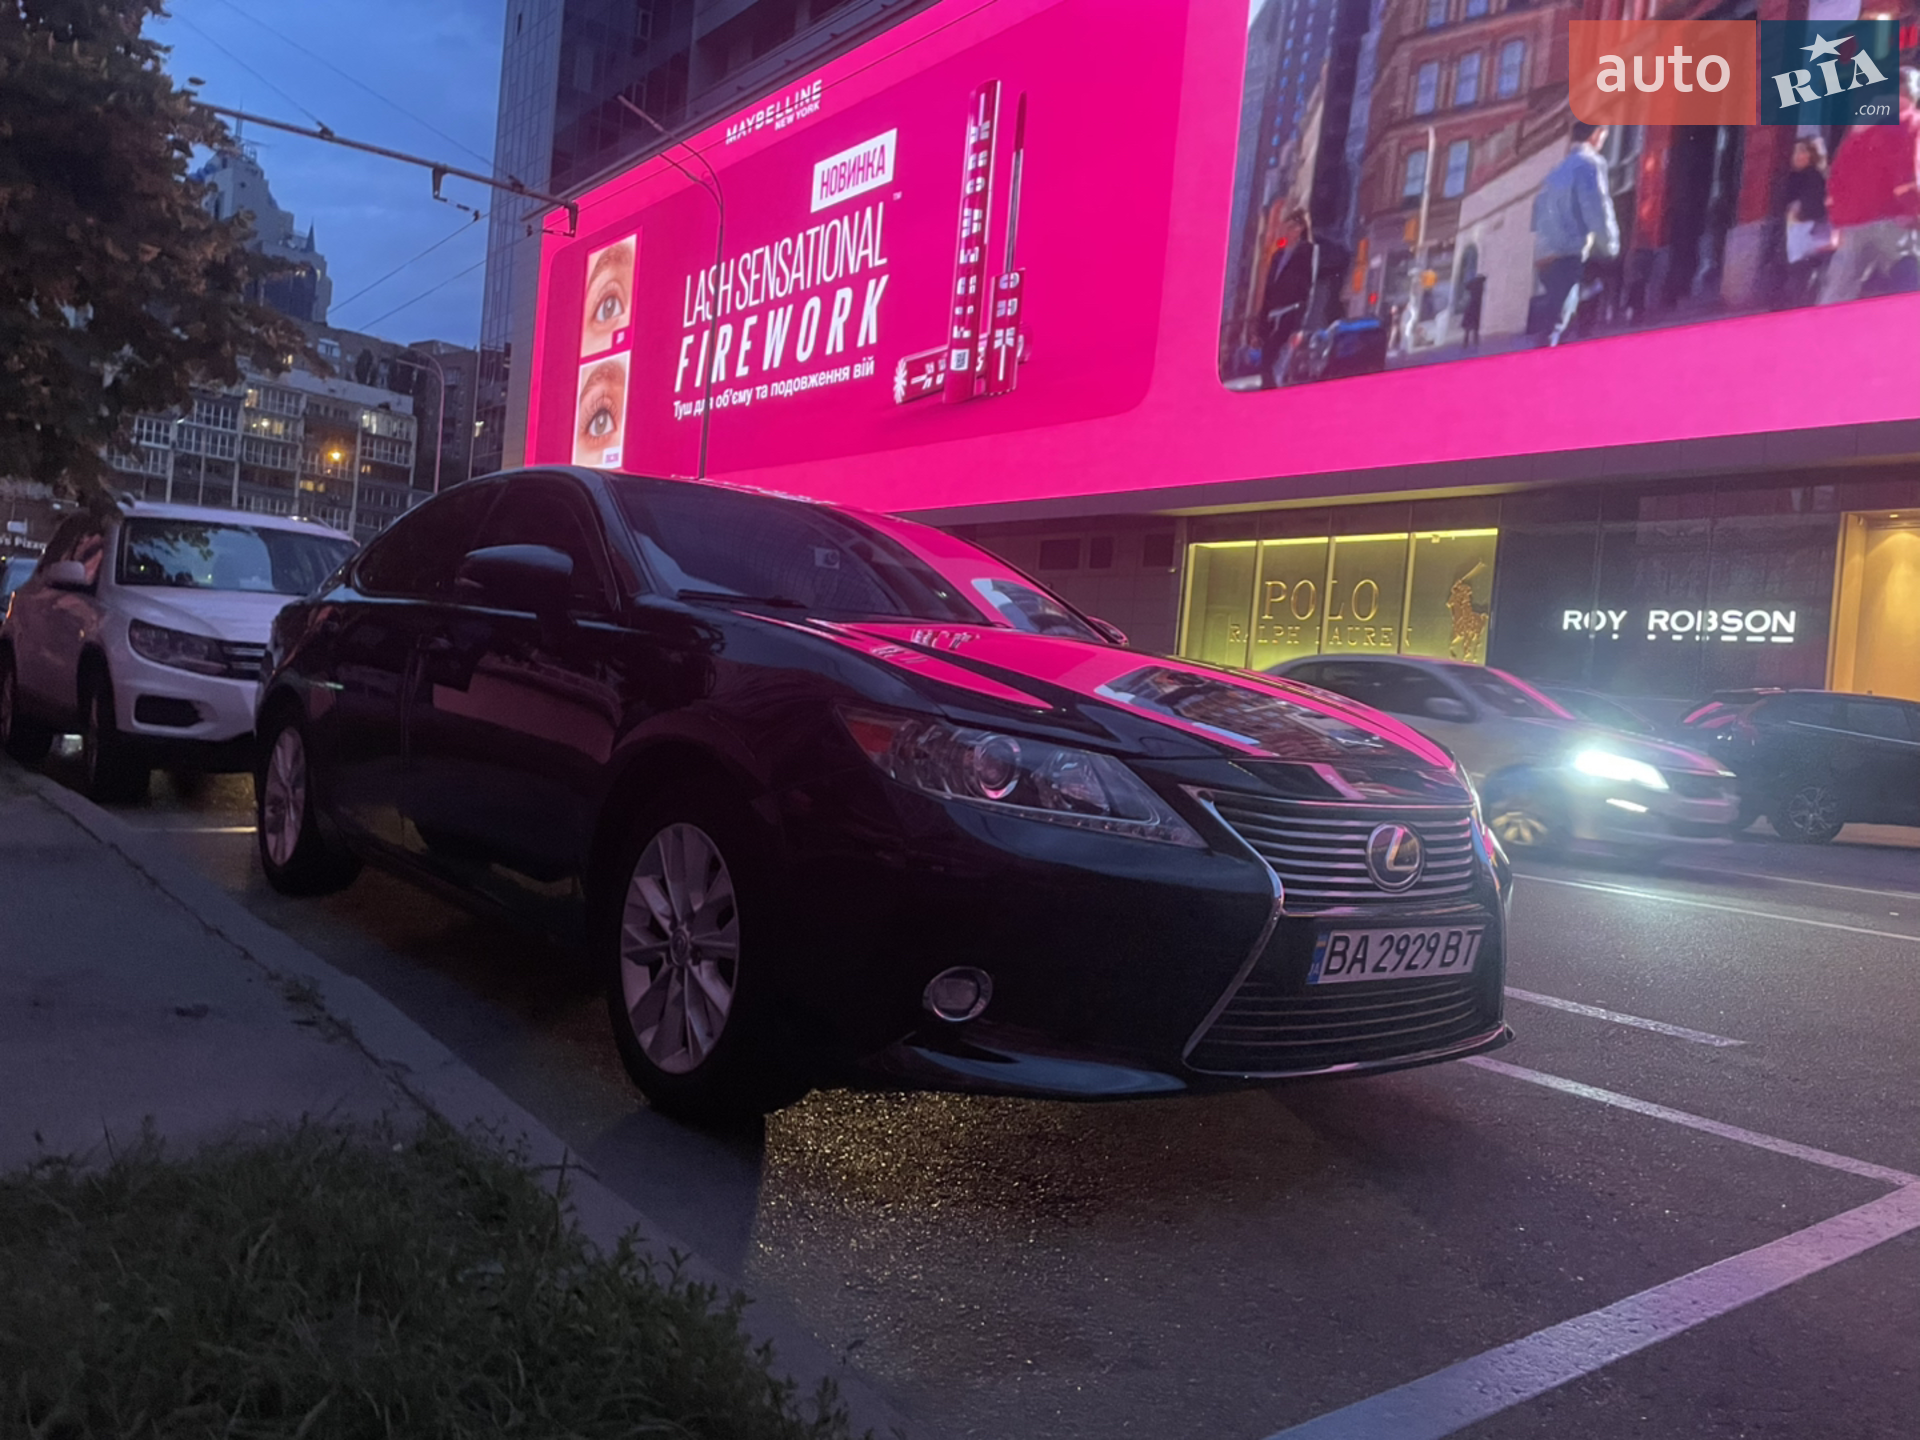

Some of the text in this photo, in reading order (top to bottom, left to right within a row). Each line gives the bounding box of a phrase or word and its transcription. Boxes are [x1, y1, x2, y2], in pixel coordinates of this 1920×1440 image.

[725, 79, 822, 145] MAYBELLINE
[775, 100, 821, 131] NEW YORK
[820, 144, 886, 200] НОВИНКА
[683, 202, 888, 328] LASH SENSATIONAL
[674, 274, 889, 393] FIREWORK
[673, 400, 693, 420] Туш
[756, 384, 768, 400] та
[770, 365, 851, 397] подовження
[853, 355, 875, 379] вій
[1261, 579, 1379, 621] POLO
[1563, 610, 1796, 634] ROY ROBSON
[1229, 624, 1301, 645] RLPH
[1323, 928, 1485, 976] BA 2929 BT
